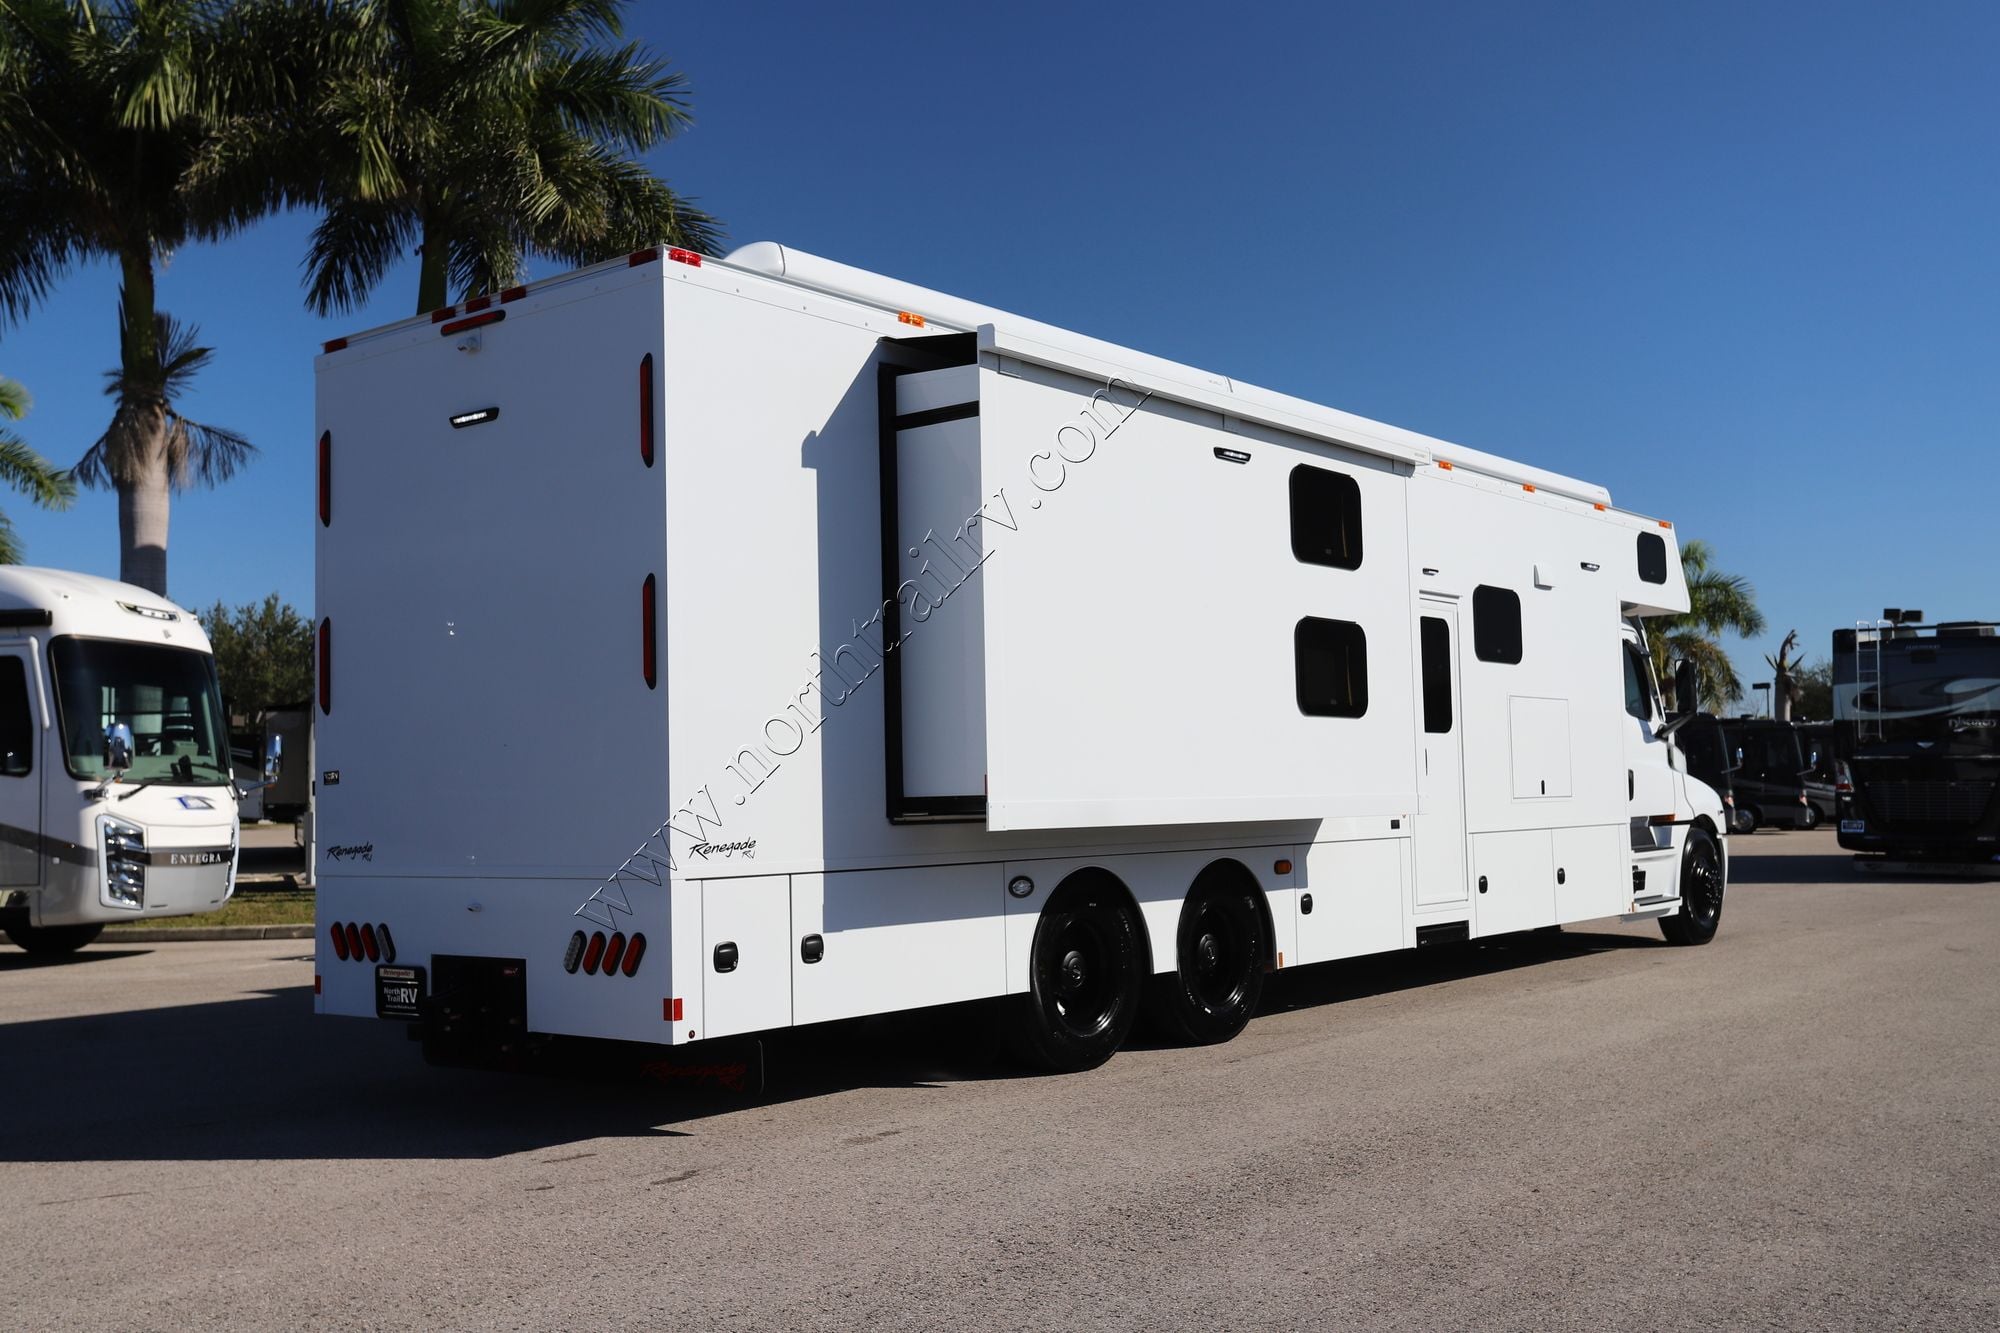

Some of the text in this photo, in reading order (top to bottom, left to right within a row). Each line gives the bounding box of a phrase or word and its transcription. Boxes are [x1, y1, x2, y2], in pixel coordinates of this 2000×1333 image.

[327, 842, 373, 862] Renegade
[689, 837, 757, 860] Renegade
[742, 850, 756, 859] RV
[170, 853, 222, 865] ENTEGRA
[383, 986, 401, 995] North
[400, 987, 418, 1004] RV
[386, 994, 401, 1003] Trail
